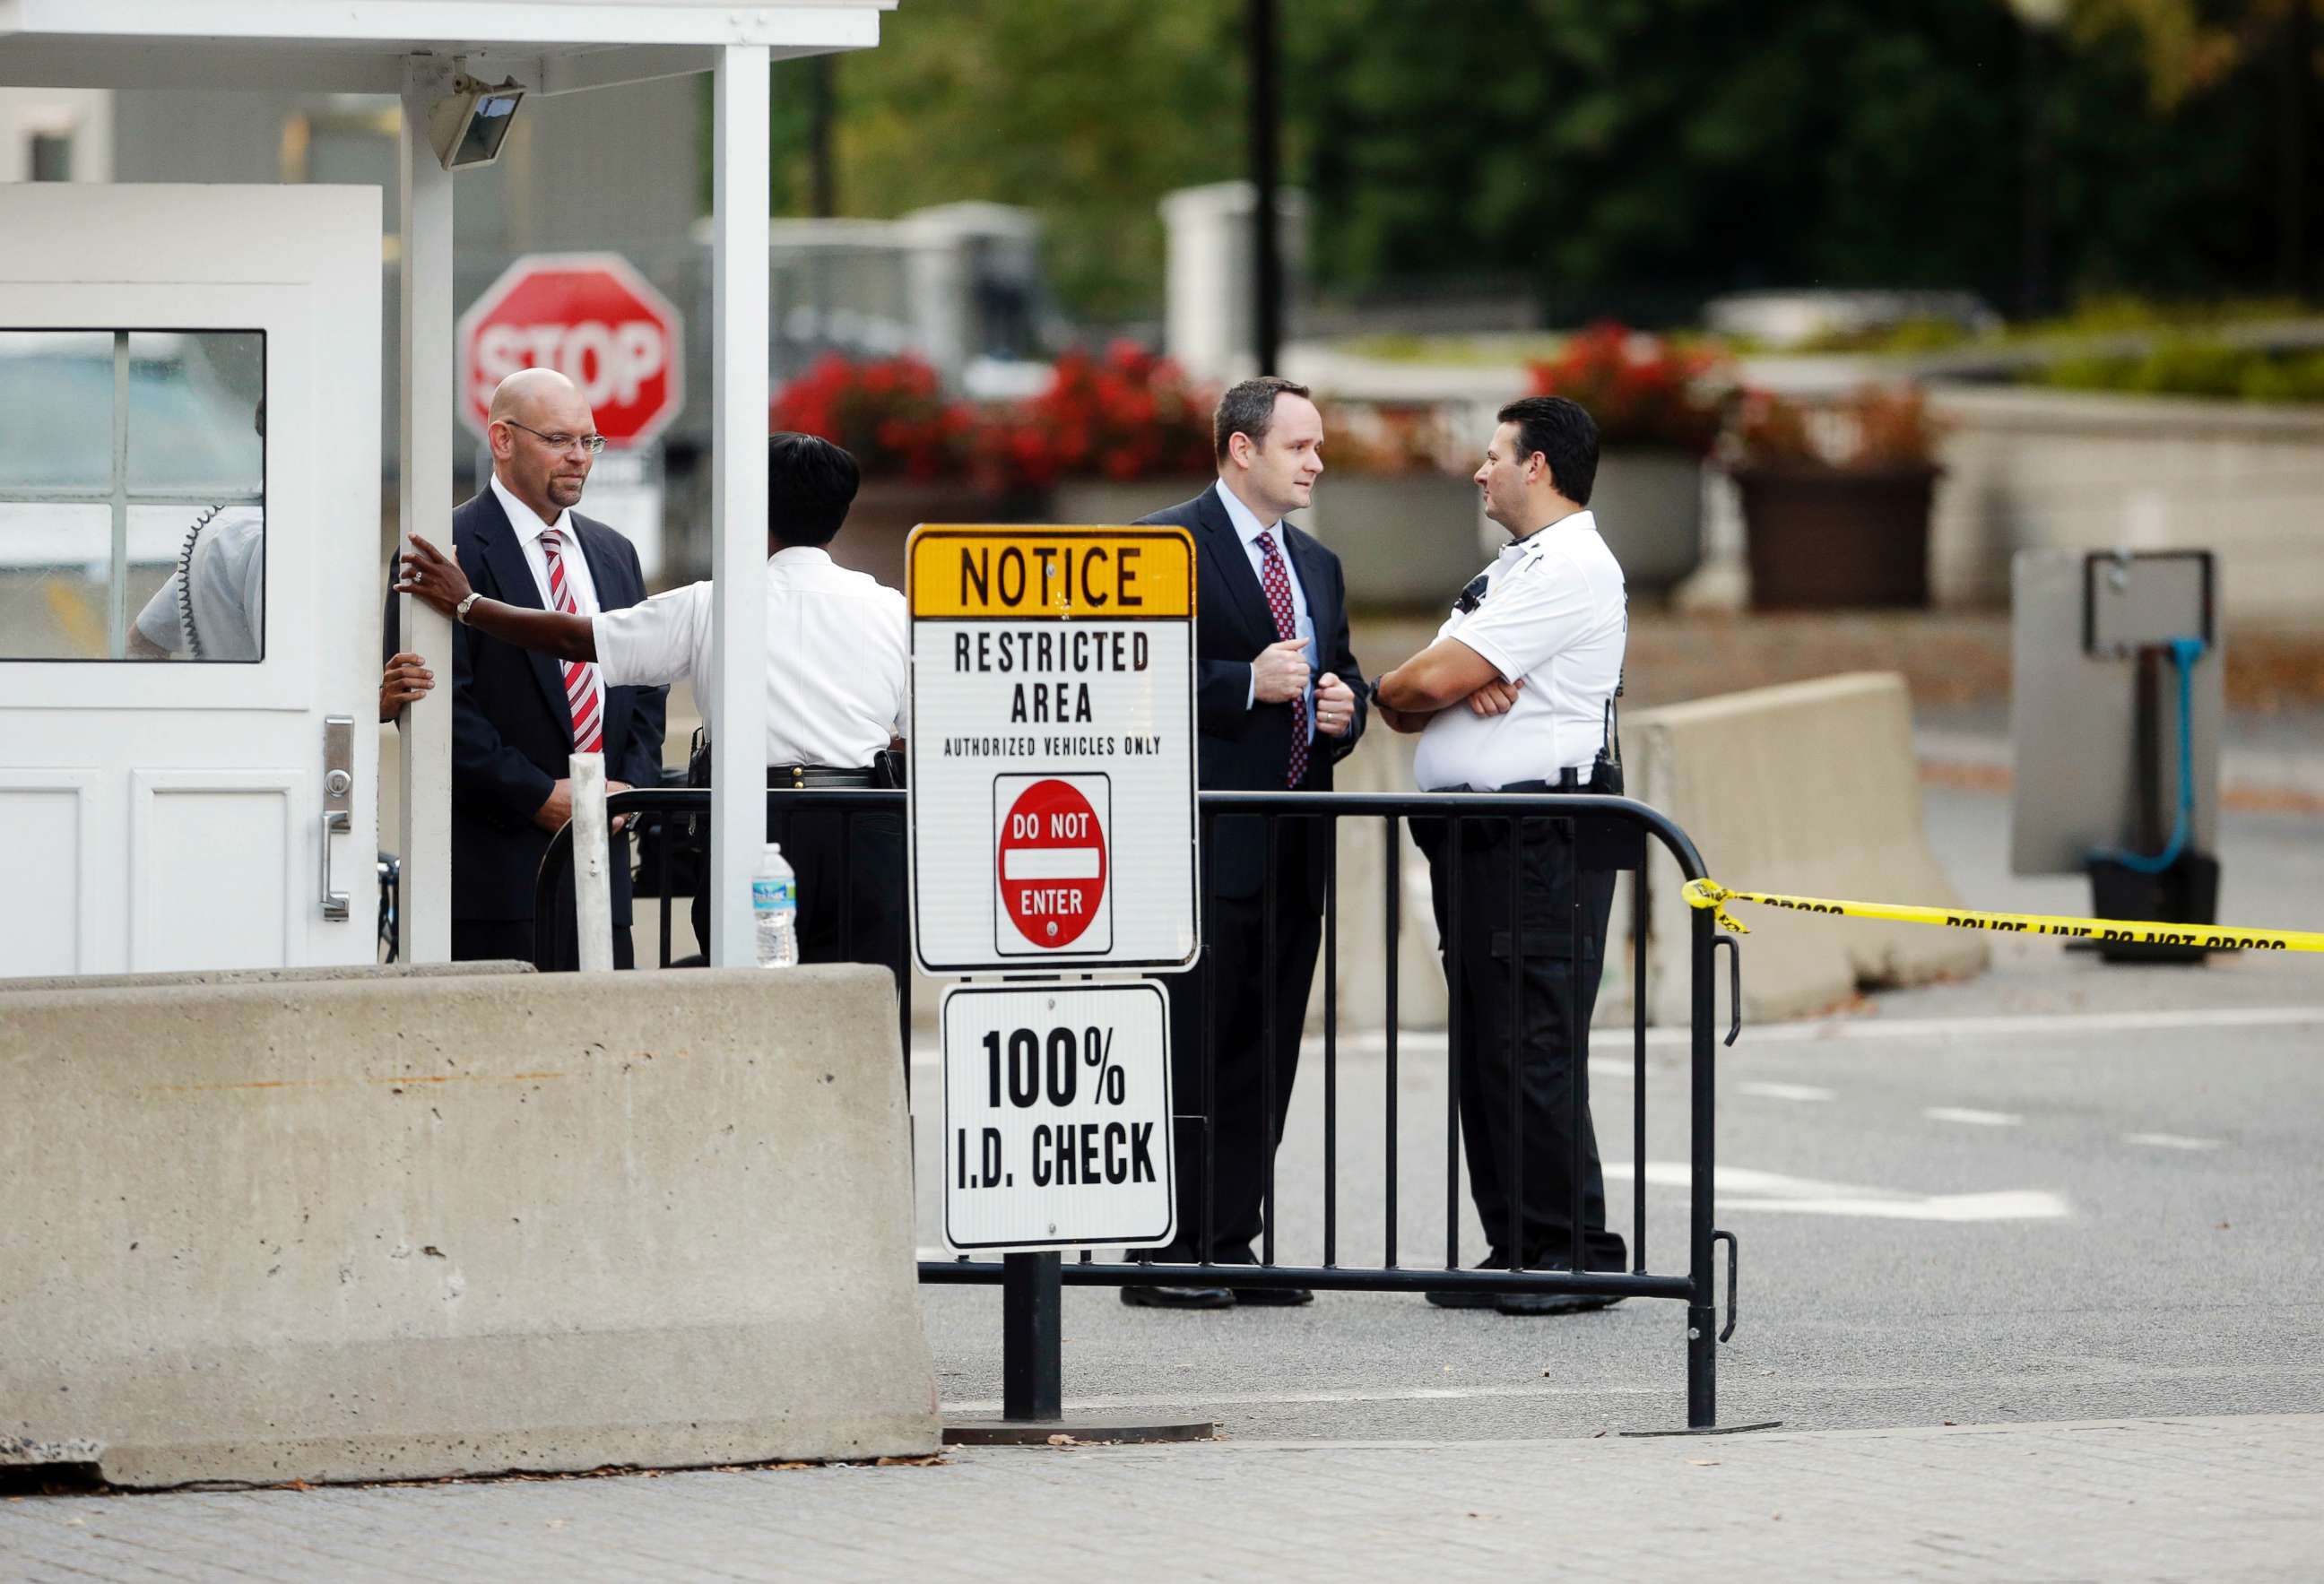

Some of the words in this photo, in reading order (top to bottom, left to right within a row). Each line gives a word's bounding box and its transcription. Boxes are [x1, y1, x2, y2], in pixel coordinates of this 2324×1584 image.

[477, 319, 663, 410] STOP
[960, 546, 1142, 606] NOTICE
[955, 631, 1149, 672] RESTRICTED
[1010, 682, 1093, 723] AREA
[944, 737, 1036, 757] AUTHORIZED
[1044, 736, 1115, 756] VEHICLES
[1123, 735, 1161, 756] ONLY
[1012, 812, 1040, 840] DO
[1050, 812, 1089, 839] NOT
[1020, 888, 1083, 916] ENTER
[982, 1026, 1125, 1108] 100%
[958, 1126, 1013, 1190] I.D.
[1032, 1121, 1157, 1188] CHECK
